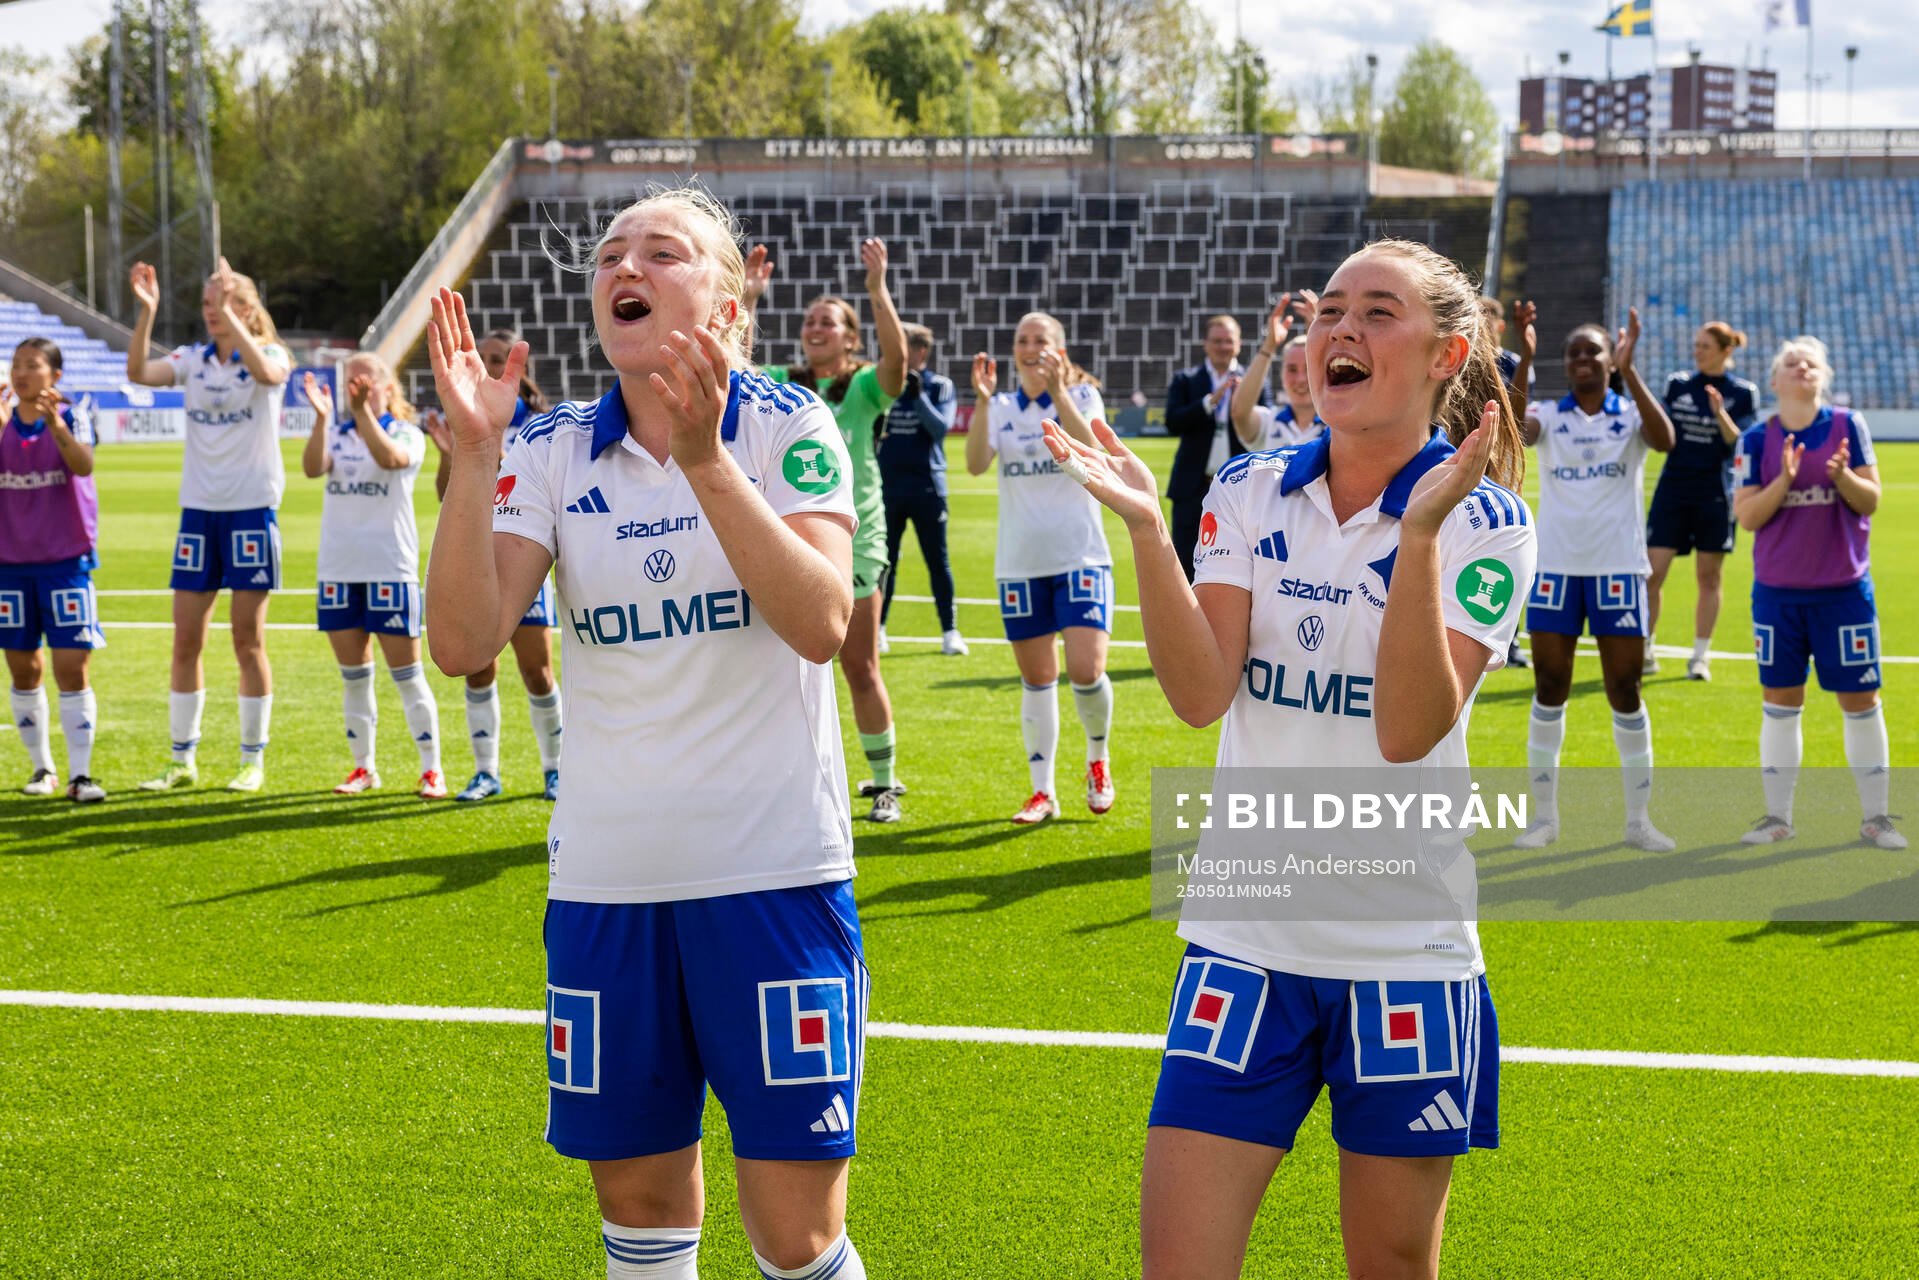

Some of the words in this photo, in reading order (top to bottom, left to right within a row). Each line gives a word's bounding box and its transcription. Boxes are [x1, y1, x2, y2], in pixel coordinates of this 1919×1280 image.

[936, 139, 962, 156] EN
[497, 506, 522, 517] SPEL
[616, 511, 698, 540] stadium
[1278, 578, 1352, 605] stadium
